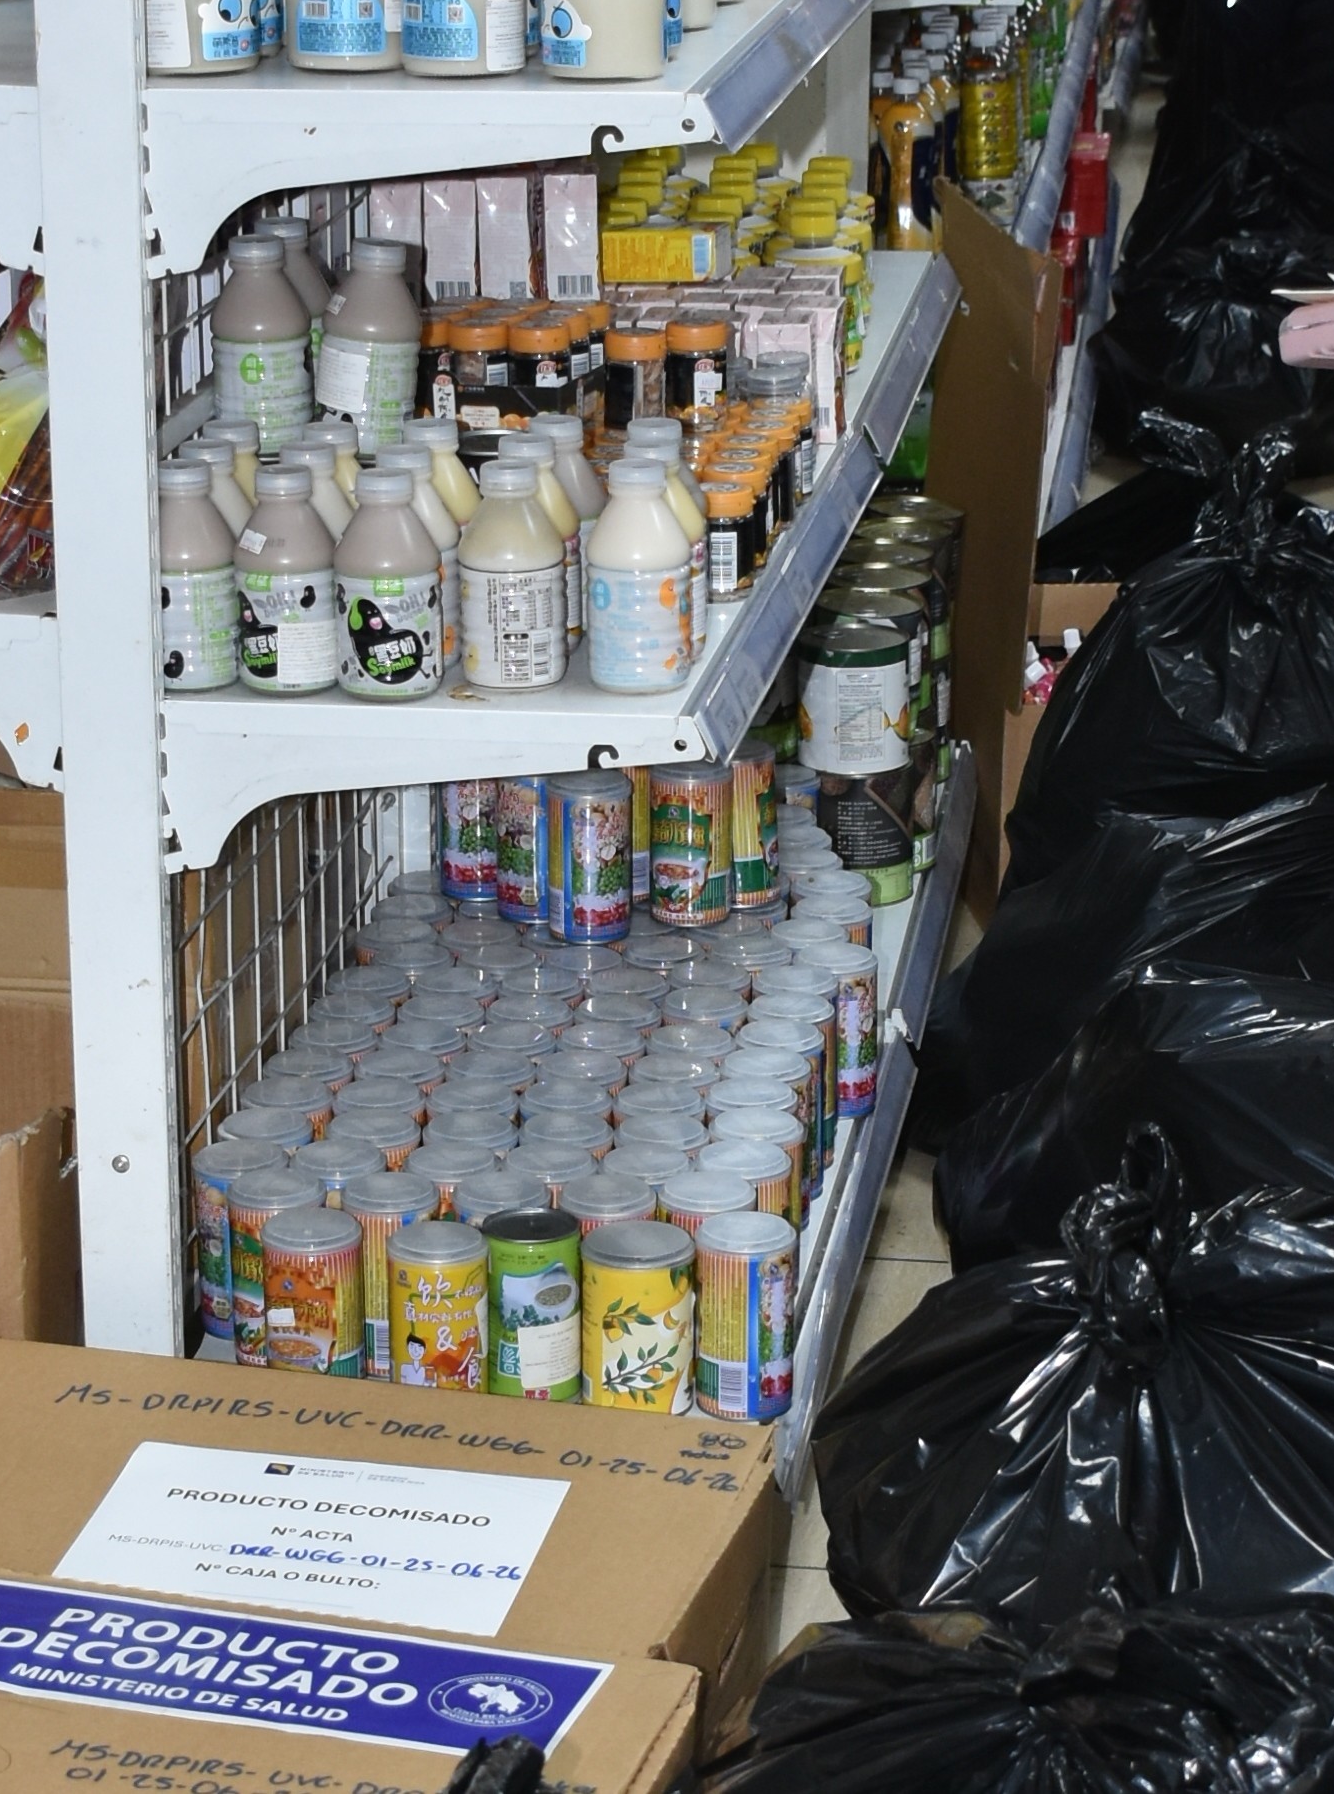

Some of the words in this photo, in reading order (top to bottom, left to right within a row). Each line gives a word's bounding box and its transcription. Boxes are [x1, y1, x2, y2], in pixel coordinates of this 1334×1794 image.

[242, 646, 278, 670] Soymil
[375, 634, 418, 665] 黑豆奶
[365, 654, 417, 678] Soymilk
[417, 1271, 454, 1310] 饮
[436, 1325, 459, 1353] &
[166, 1487, 308, 1511] PRODUCTO
[313, 1501, 492, 1528] DECOMISADO
[299, 1529, 354, 1543] ACTA
[224, 1565, 278, 1580] CAJA
[282, 1570, 301, 1582] O
[303, 1572, 382, 1590] BULTO:
[50, 1607, 400, 1675] PRODUCTO
[9, 1662, 189, 1701] MINISTERIO
[192, 1687, 238, 1707] DE
[249, 1698, 349, 1723] SALUD
